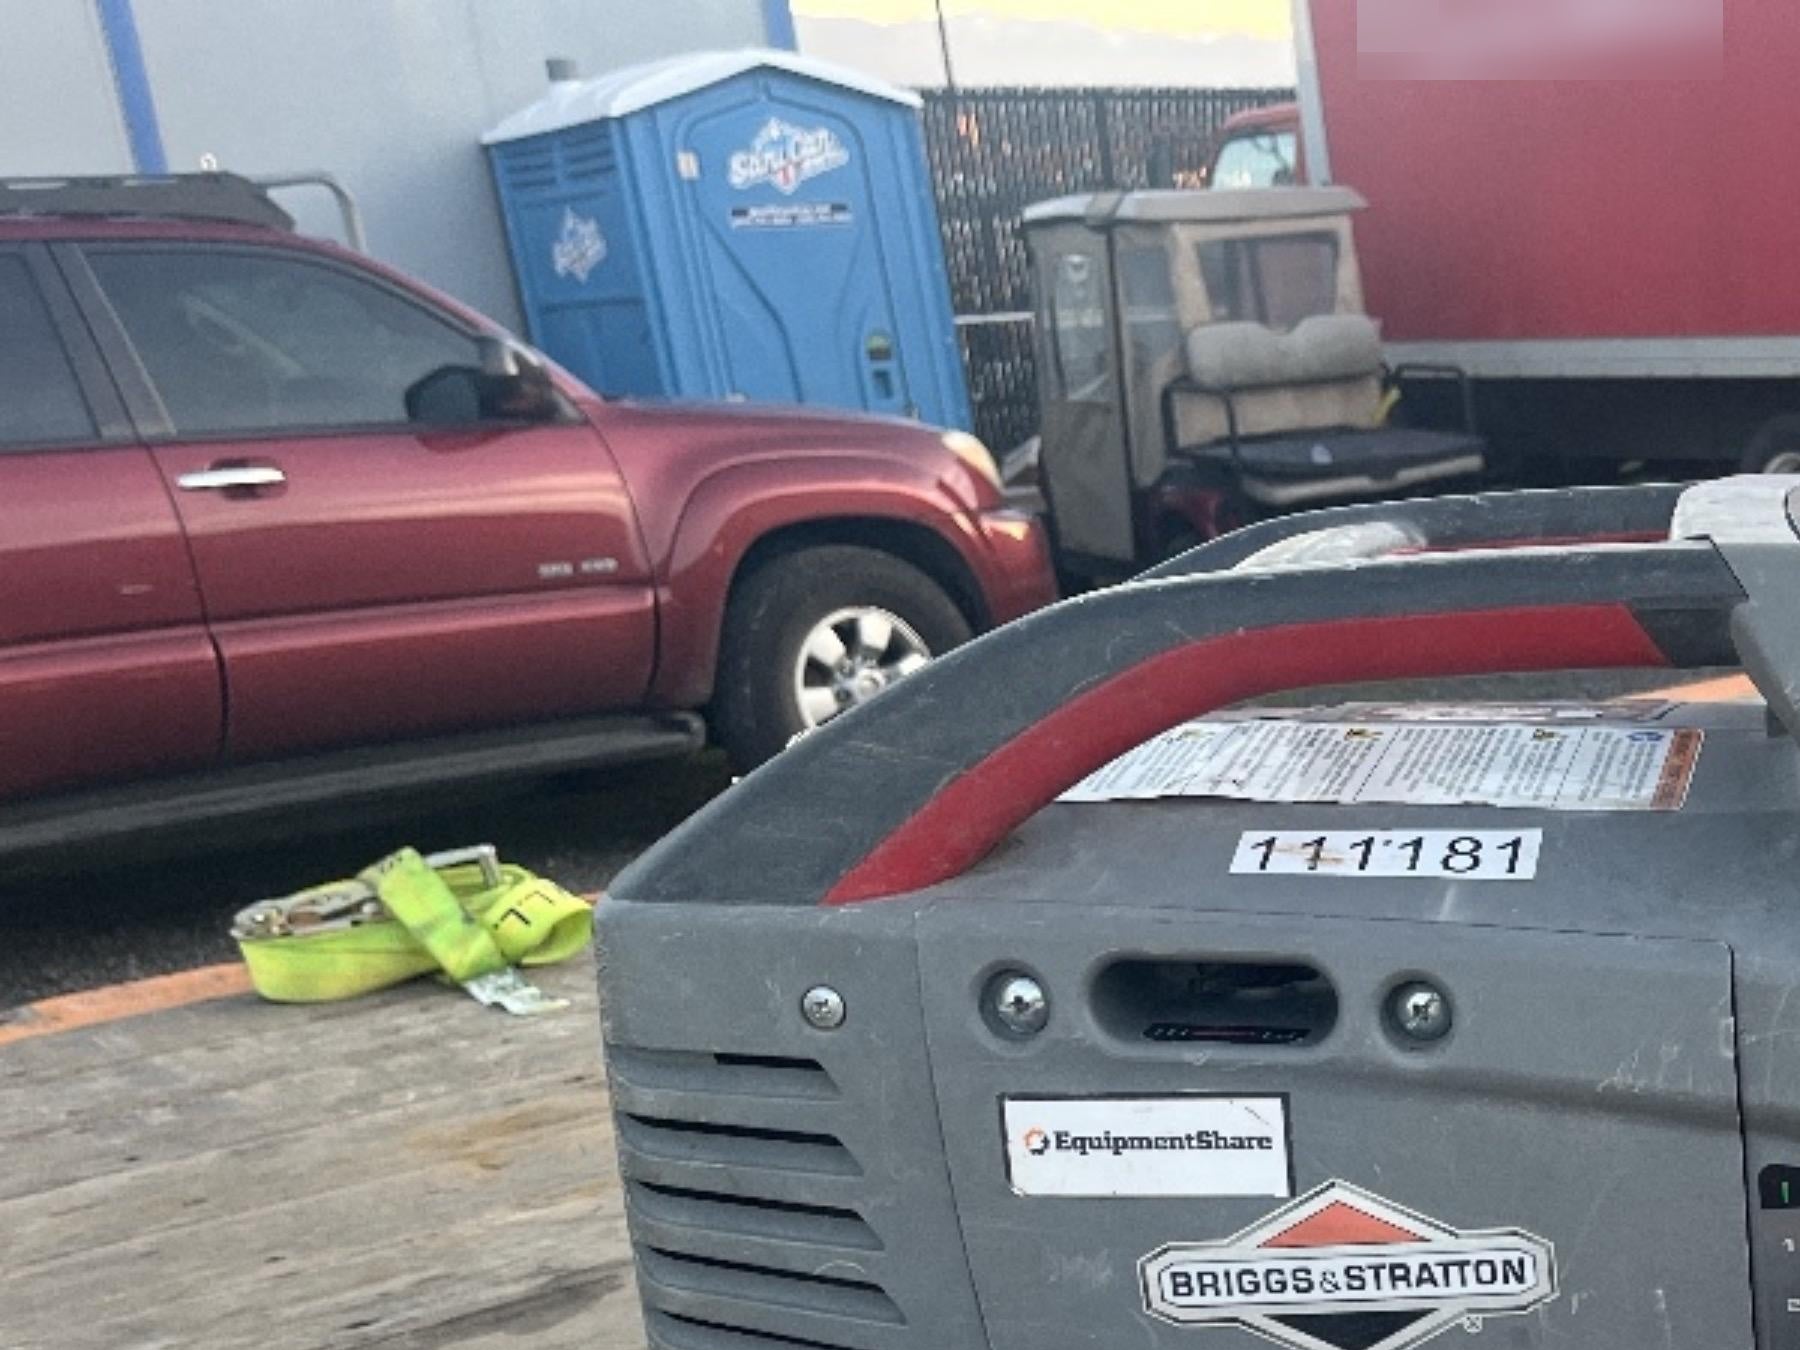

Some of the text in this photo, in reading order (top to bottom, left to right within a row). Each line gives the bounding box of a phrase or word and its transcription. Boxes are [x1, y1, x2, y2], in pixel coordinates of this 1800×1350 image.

[1250, 836, 1524, 874] 111181
[1053, 1130, 1274, 1154] EquipmentShare
[1169, 1257, 1527, 1299] BRIGGS&STRATTON
